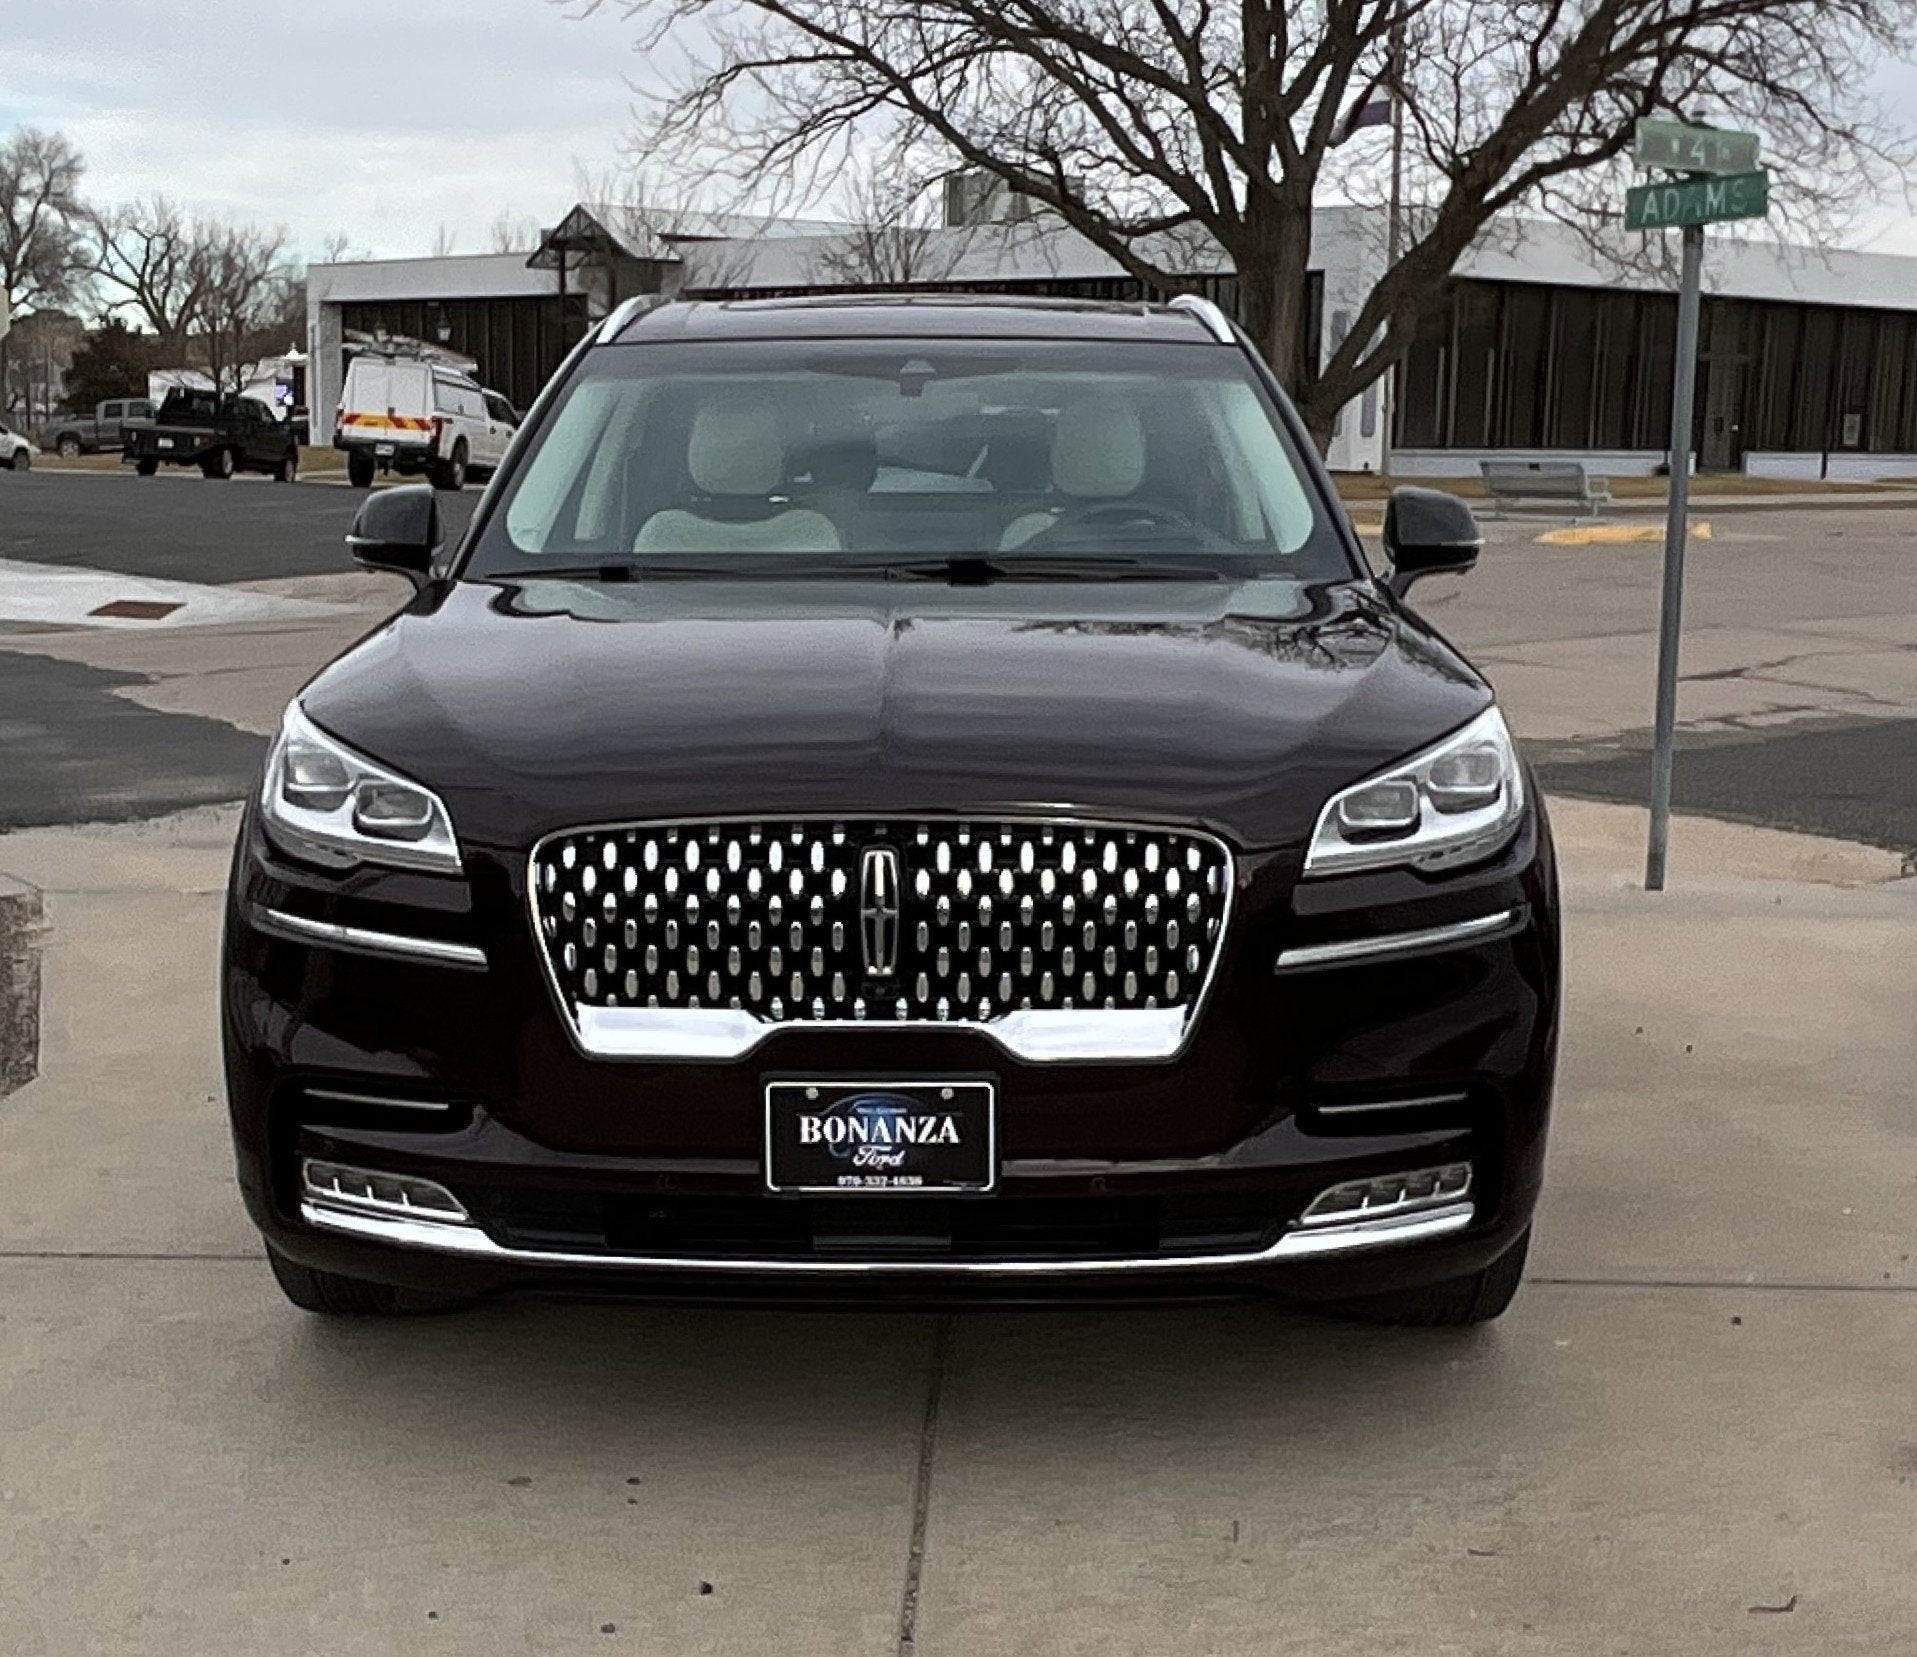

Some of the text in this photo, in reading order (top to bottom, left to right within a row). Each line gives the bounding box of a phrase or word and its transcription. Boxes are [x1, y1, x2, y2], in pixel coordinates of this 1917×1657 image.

[1641, 178, 1748, 224] ADAMS
[800, 1115, 960, 1144] BONANZA
[853, 1145, 906, 1170] Ford
